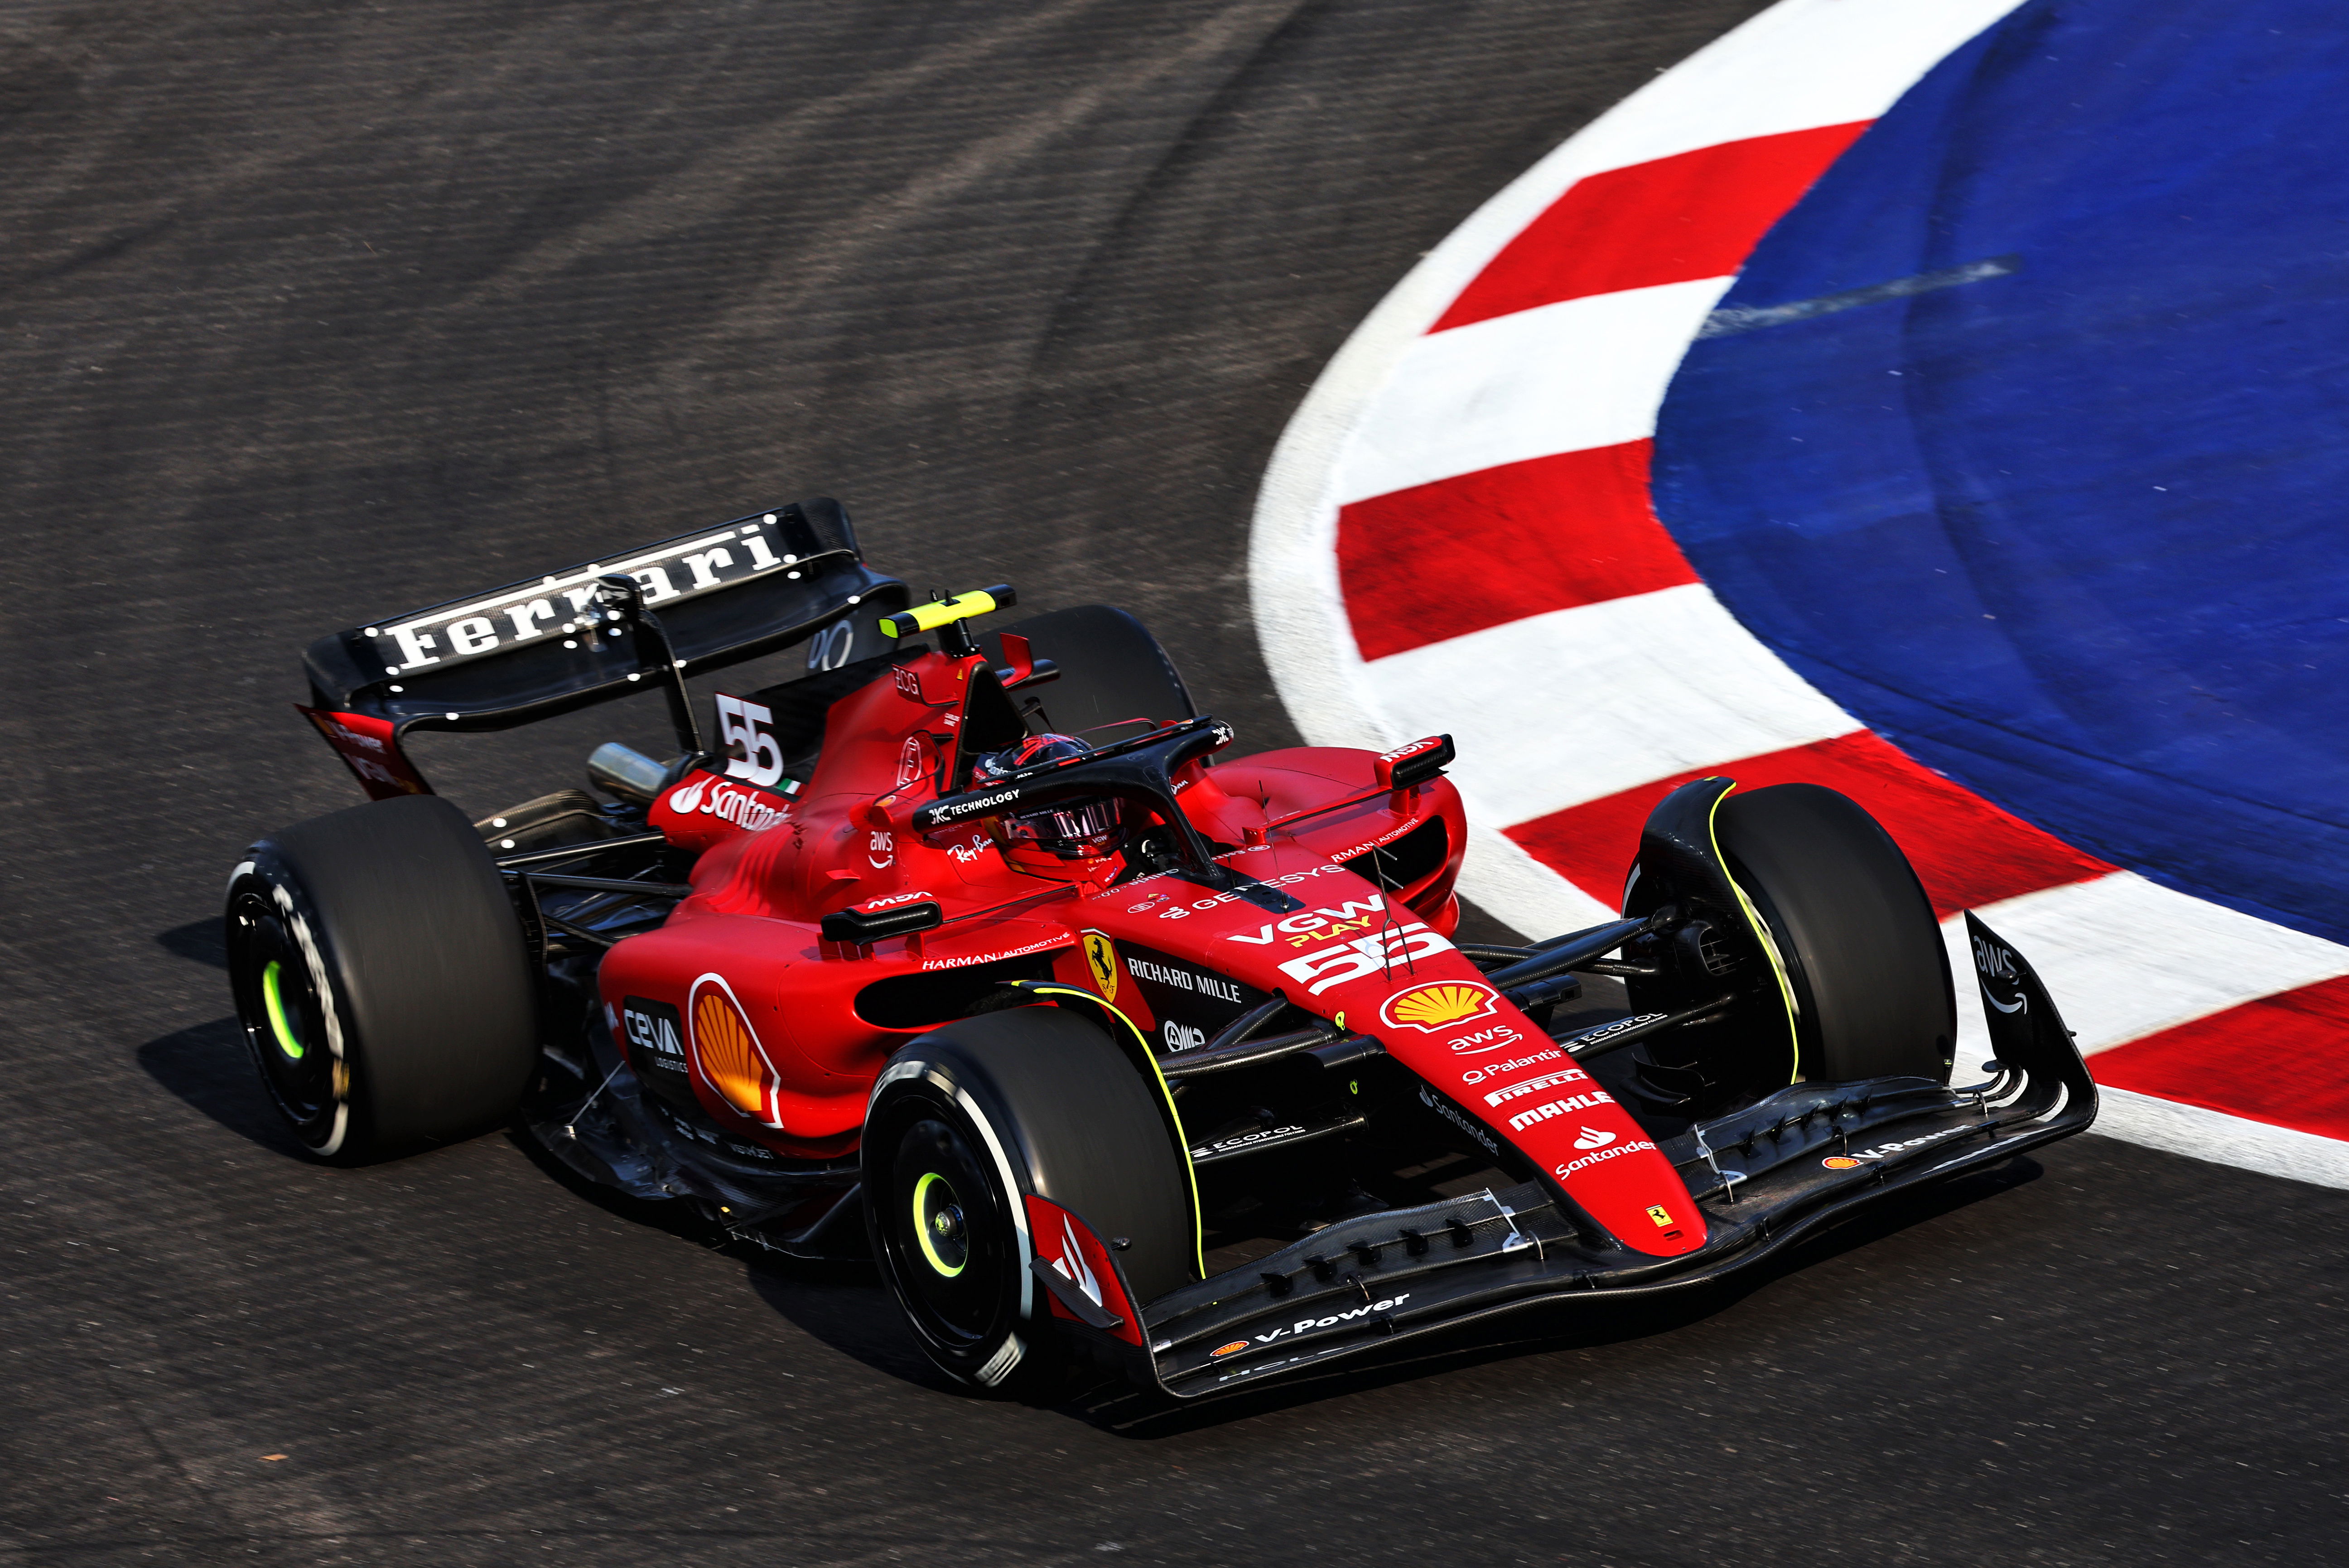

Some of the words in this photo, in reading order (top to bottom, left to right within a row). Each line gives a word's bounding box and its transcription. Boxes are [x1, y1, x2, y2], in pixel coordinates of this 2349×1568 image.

[384, 524, 782, 669] Ferrari
[715, 692, 783, 787] 55
[950, 789, 1019, 815] TECHNOLOGY
[870, 831, 893, 852] aws
[1331, 841, 1374, 863] RMAN
[1379, 818, 1418, 843] AUTOMOTIVE
[1192, 864, 1346, 910] GENESYS
[1226, 894, 1386, 945] VGW
[1285, 915, 1371, 948] PLAY
[922, 953, 996, 970] HARMAN
[1003, 932, 1070, 958] AUTOMOTIVE
[1277, 922, 1457, 996] 55
[1973, 936, 2019, 985] aws
[1128, 957, 1192, 990] RICHARD
[1196, 975, 1241, 1004] MILLE
[624, 1009, 684, 1056] CEVA
[1447, 1025, 1513, 1051] aws
[1580, 1013, 1663, 1042] ECOPOL
[1590, 1031, 1621, 1045] BIODEGRADABLE
[1621, 1022, 1649, 1034] HYDROSOLUBLE
[1648, 1014, 1668, 1024] POLYMERS
[1484, 1049, 1562, 1076] Palantir
[1483, 1068, 1588, 1108] PIRELLI
[1432, 1095, 1499, 1156] Santander
[1509, 1091, 1615, 1132] MAHLE
[1213, 1125, 1302, 1148] ECOPOL
[1218, 1141, 1252, 1152] BIODEGRADABLE
[1253, 1134, 1284, 1144] HYDROSOLUBLE
[1850, 1124, 1973, 1159] V-Power
[1555, 1141, 1657, 1180] Santander
[1254, 1293, 1410, 1343] V-Power
